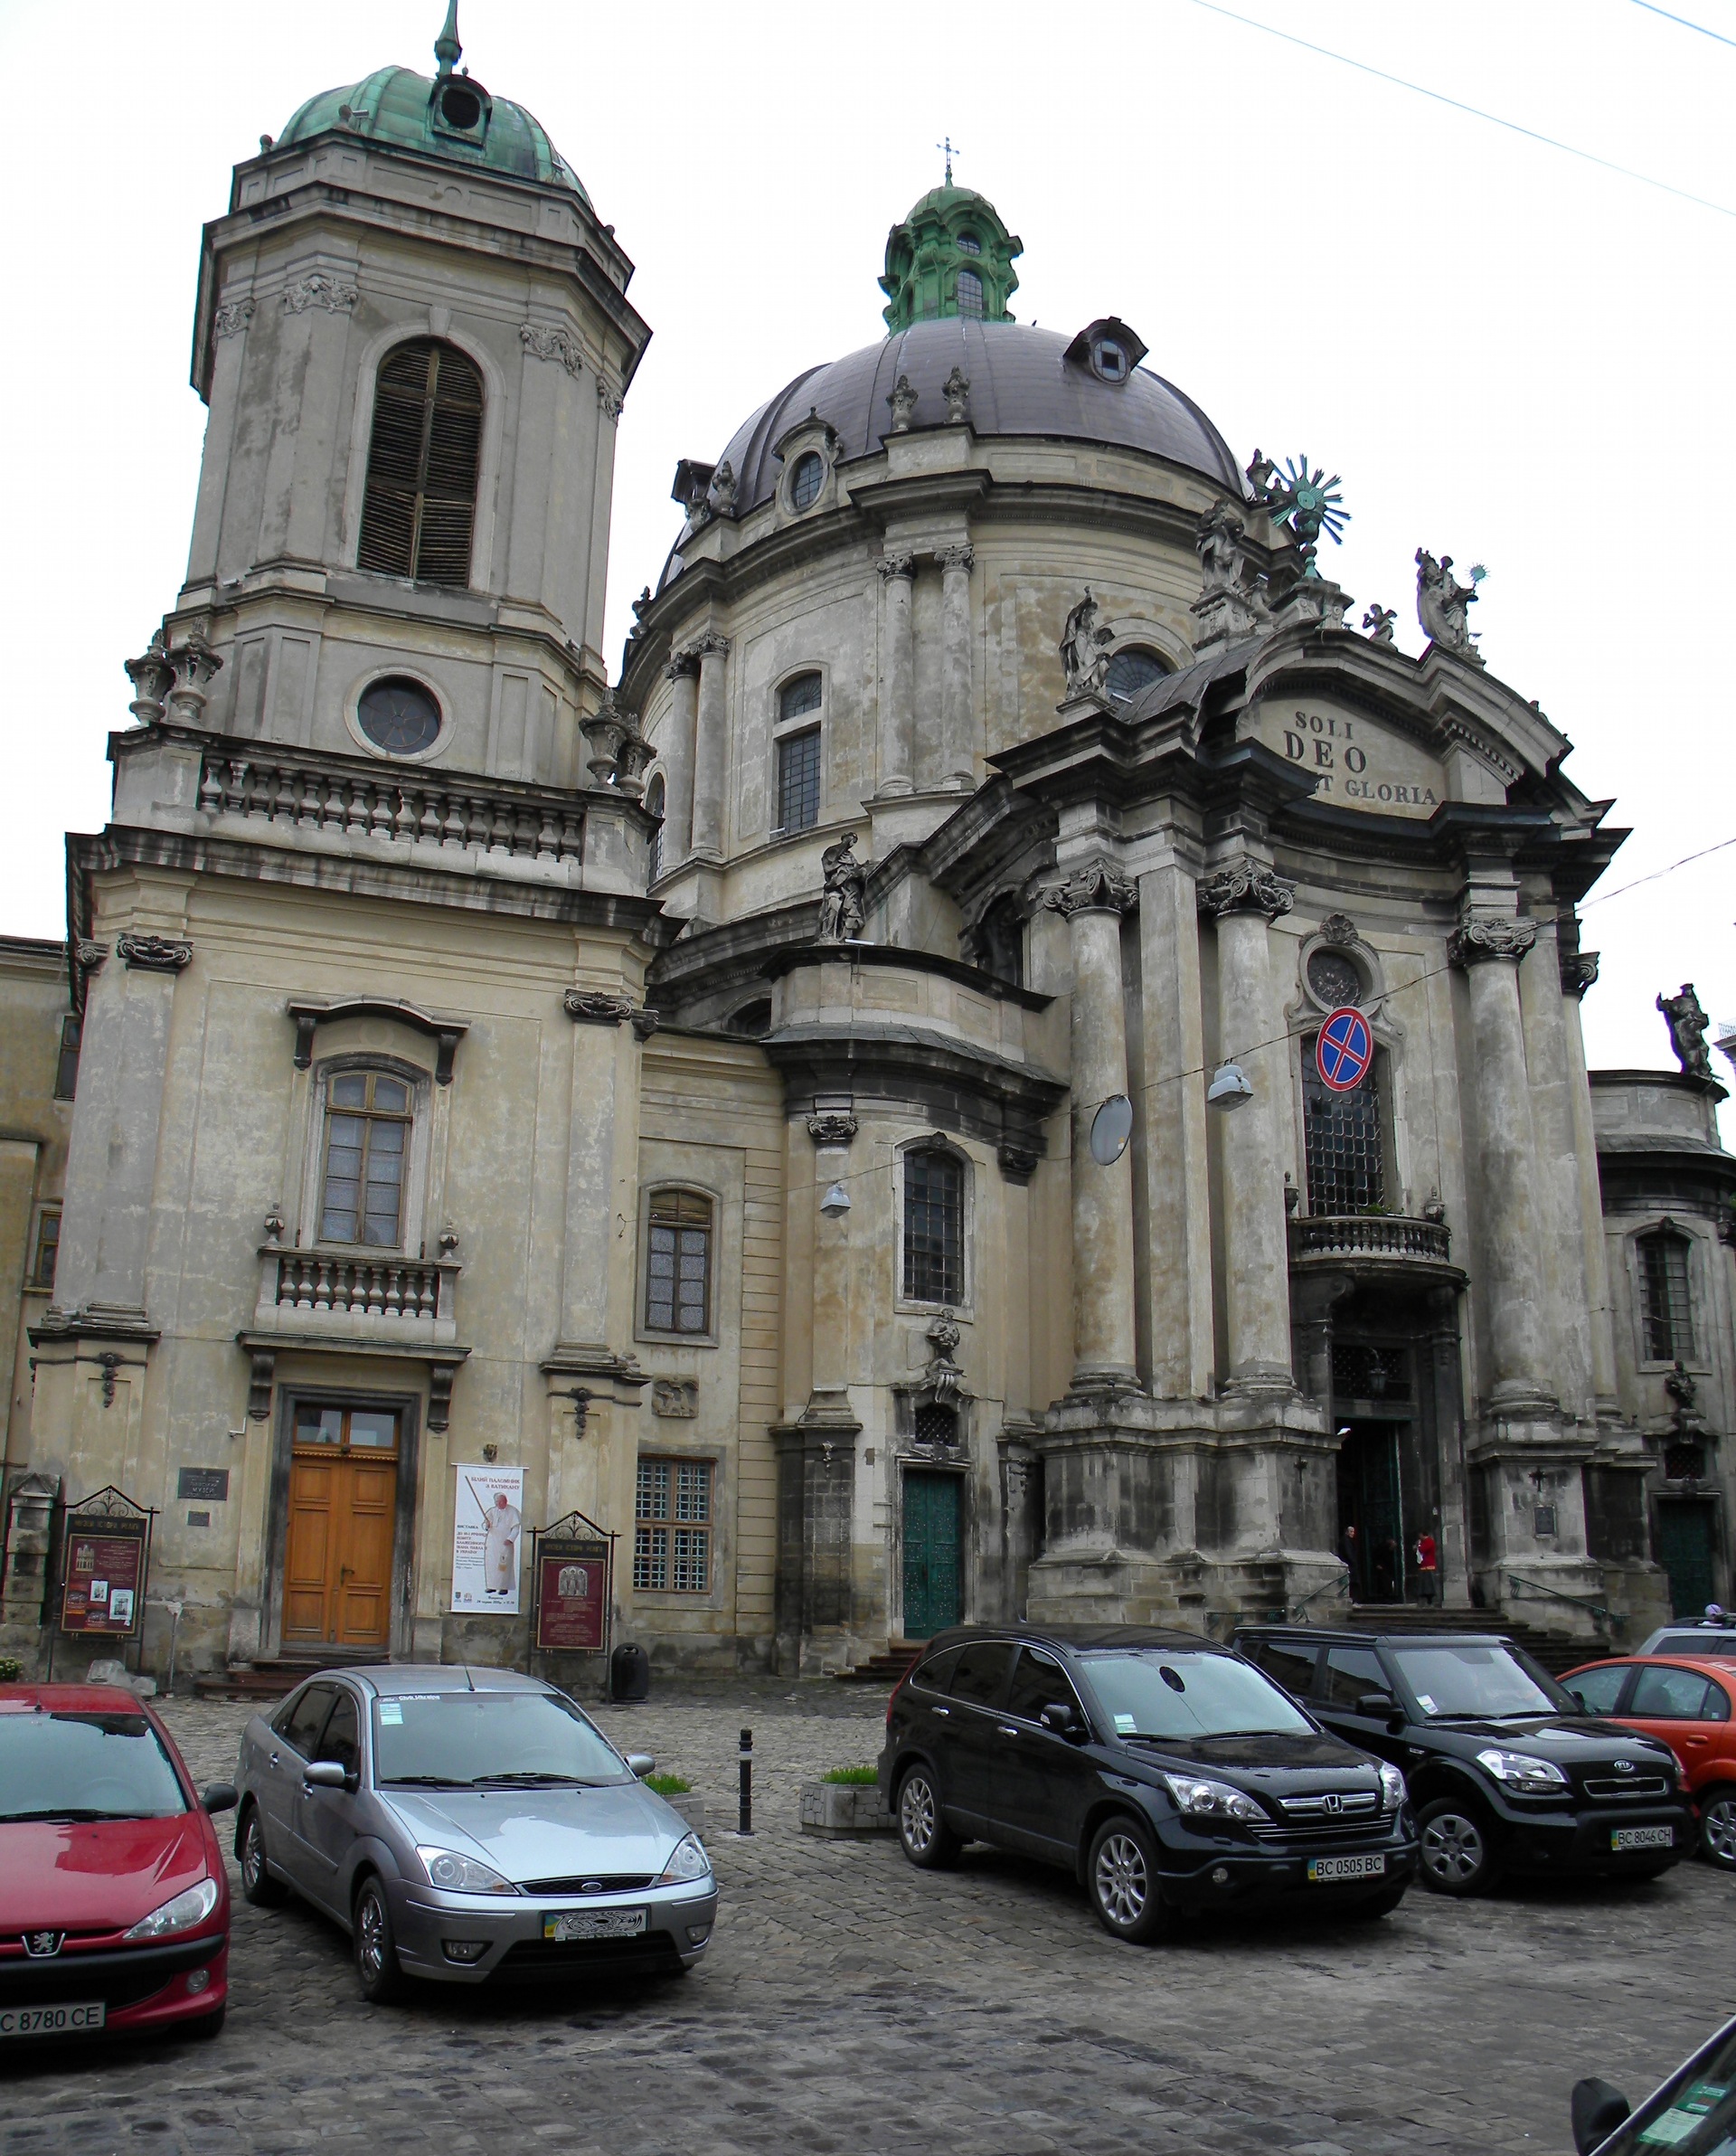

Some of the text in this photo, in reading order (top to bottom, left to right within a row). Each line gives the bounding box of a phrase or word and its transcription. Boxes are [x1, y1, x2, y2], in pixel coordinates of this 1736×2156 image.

[1295, 710, 1354, 740] SOLI
[1283, 730, 1367, 773] DEO
[1344, 779, 1439, 806] GLORIA
[1618, 1829, 1671, 1845] BC 8046 CH
[1316, 1857, 1382, 1876] BC 0505 BC
[20, 2009, 67, 2031] 8780
[71, 2006, 99, 2027] CE
